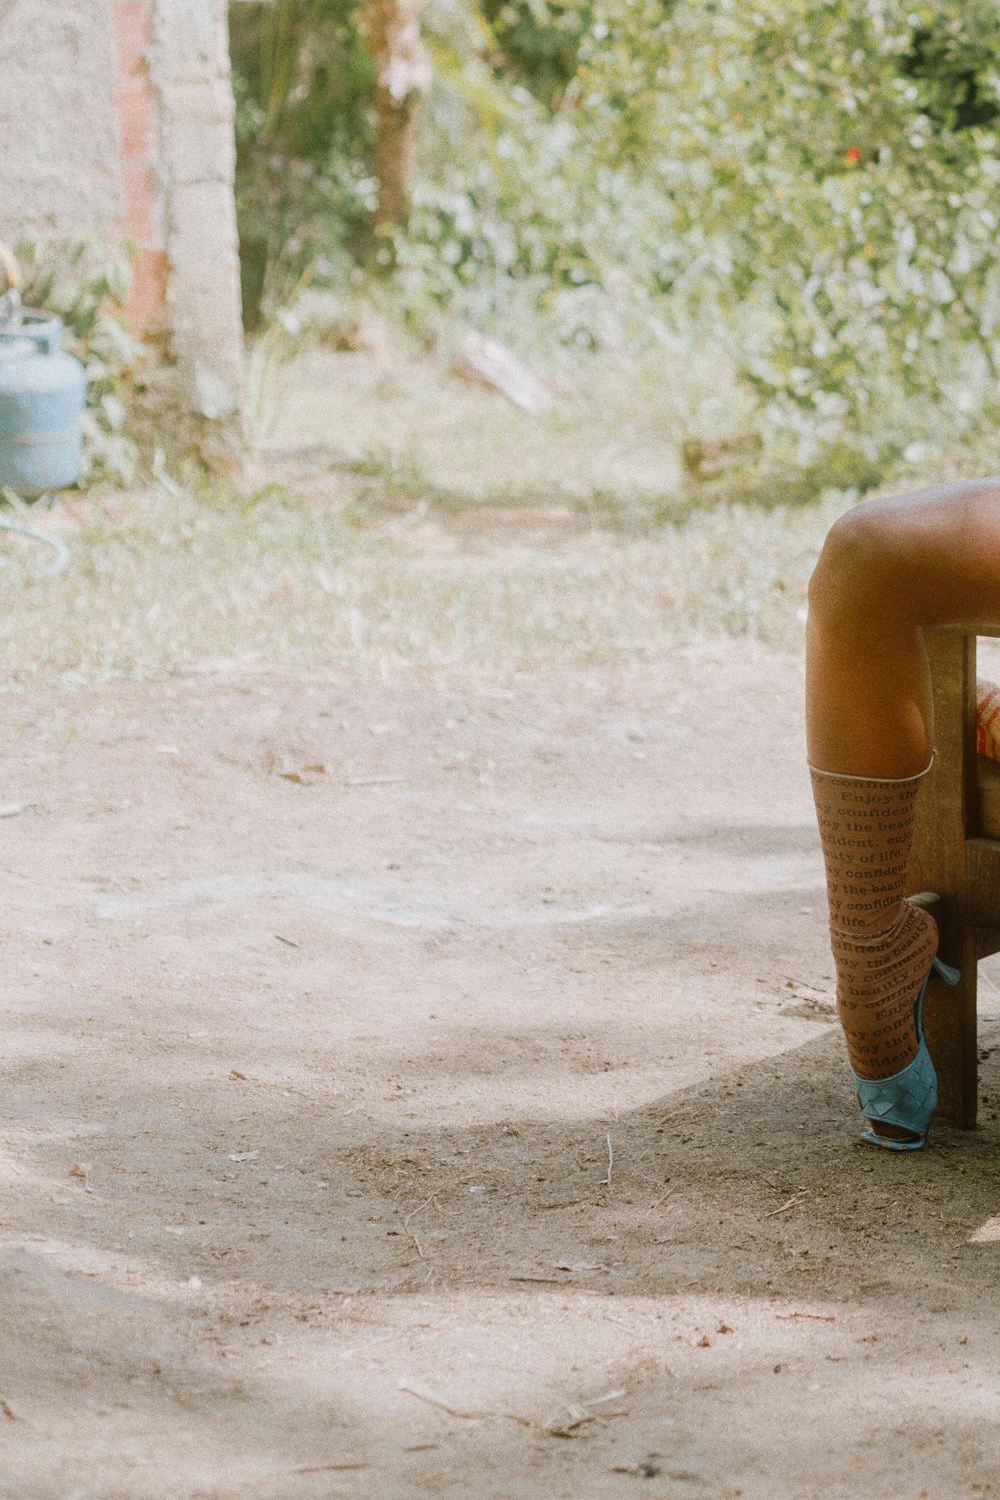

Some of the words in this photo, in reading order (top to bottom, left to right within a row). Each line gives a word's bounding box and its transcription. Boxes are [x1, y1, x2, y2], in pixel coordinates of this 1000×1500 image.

[841, 791, 892, 805] Enjoy
[837, 803, 913, 818] confident
[847, 821, 872, 832] the
[859, 853, 875, 864] of
[843, 884, 868, 896] the
